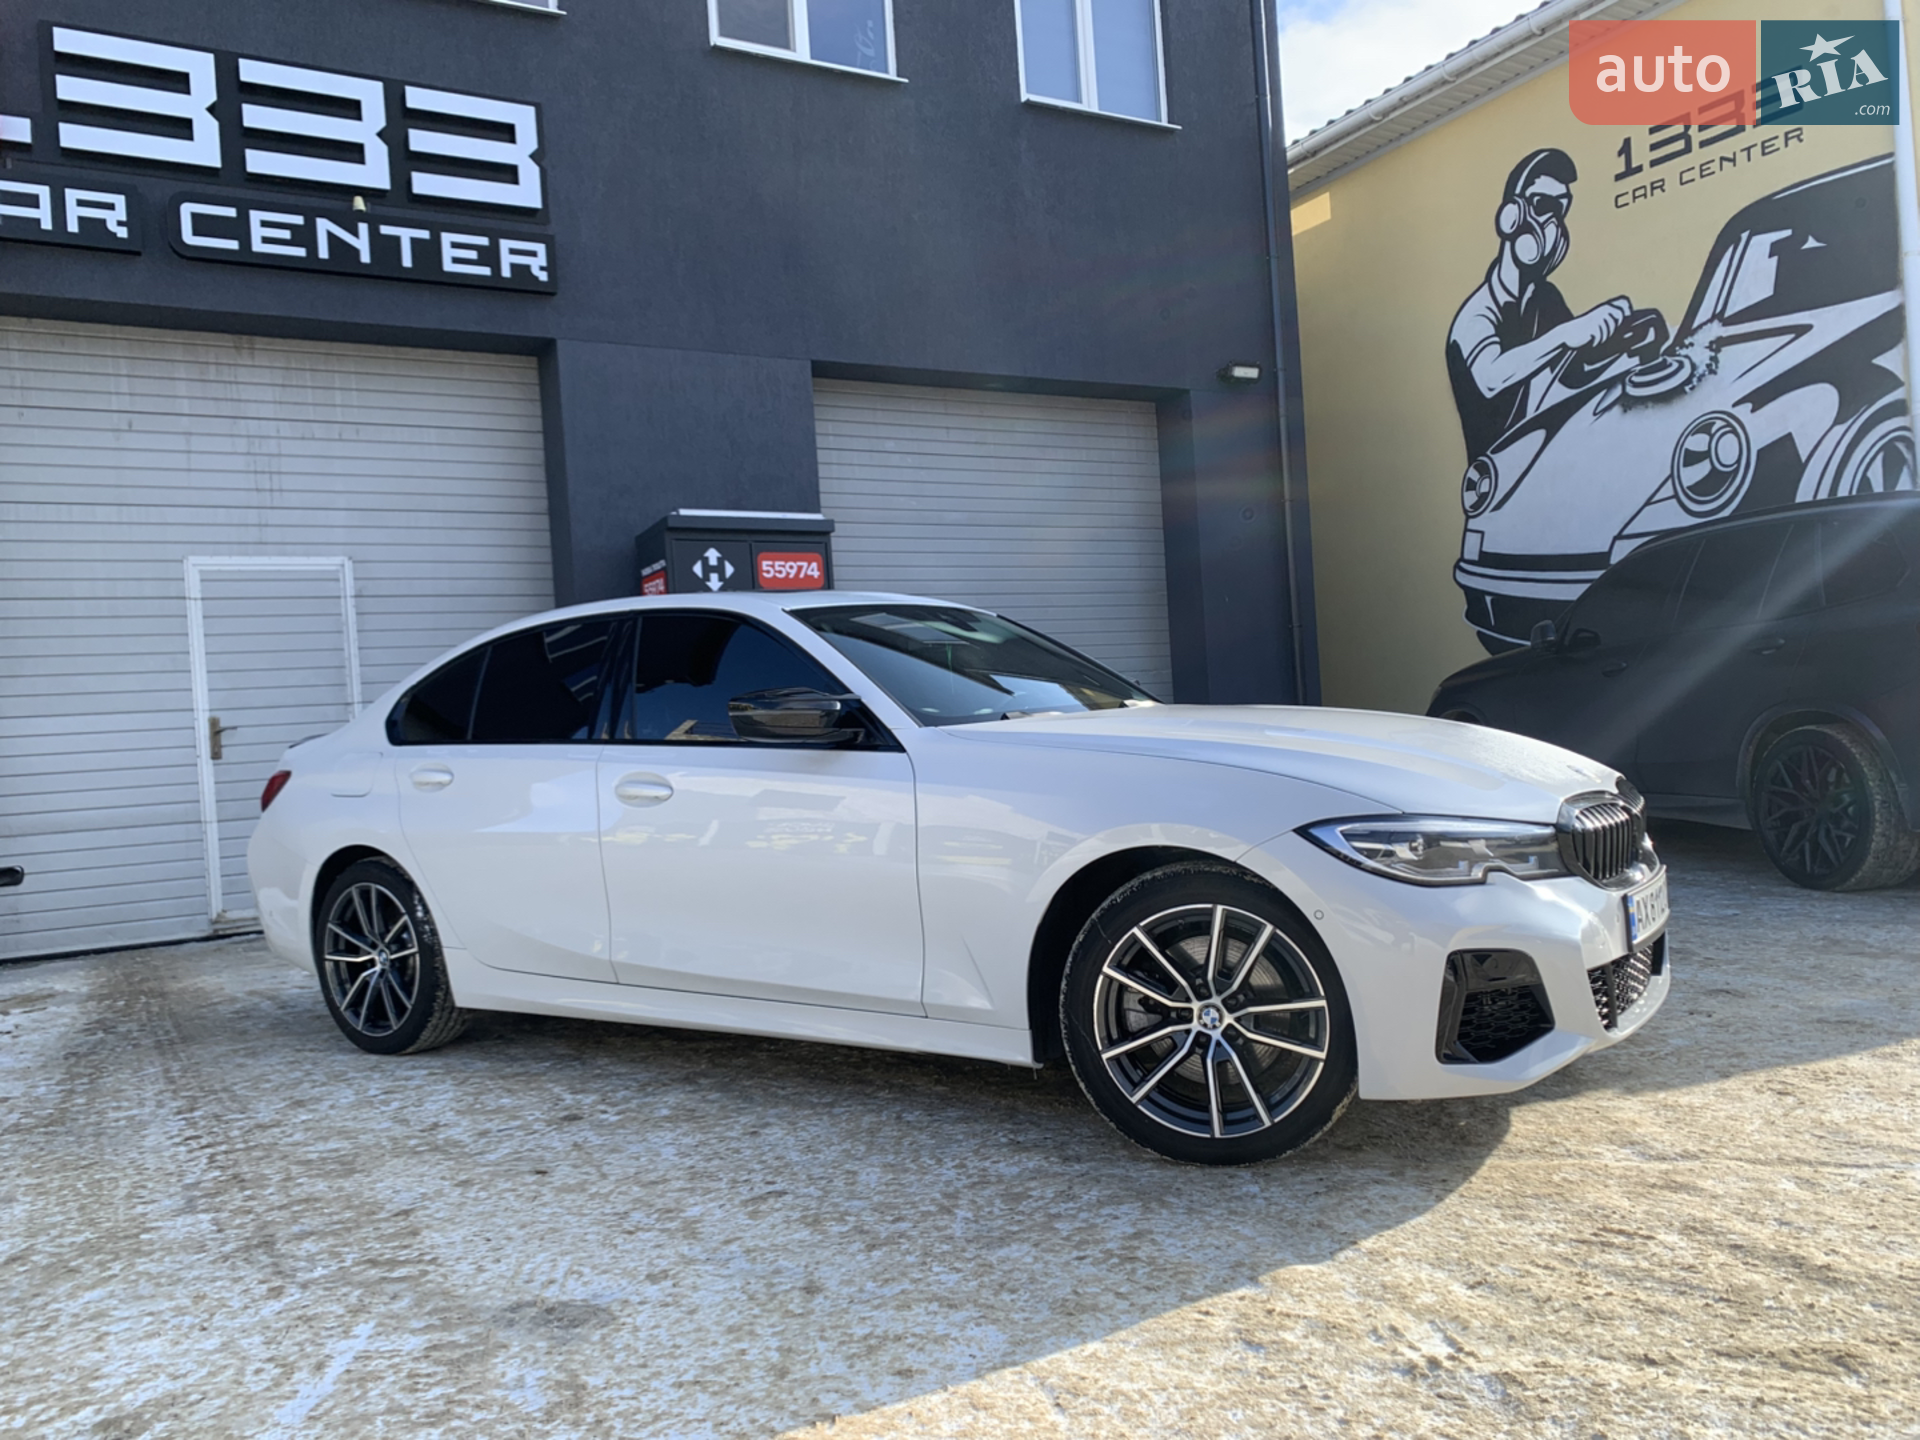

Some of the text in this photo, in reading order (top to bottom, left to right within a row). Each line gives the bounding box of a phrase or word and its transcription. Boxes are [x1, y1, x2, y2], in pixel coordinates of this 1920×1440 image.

[1614, 127, 1805, 209] CAR CENTER
[180, 202, 549, 282] CENTER
[761, 560, 820, 579] 55974
